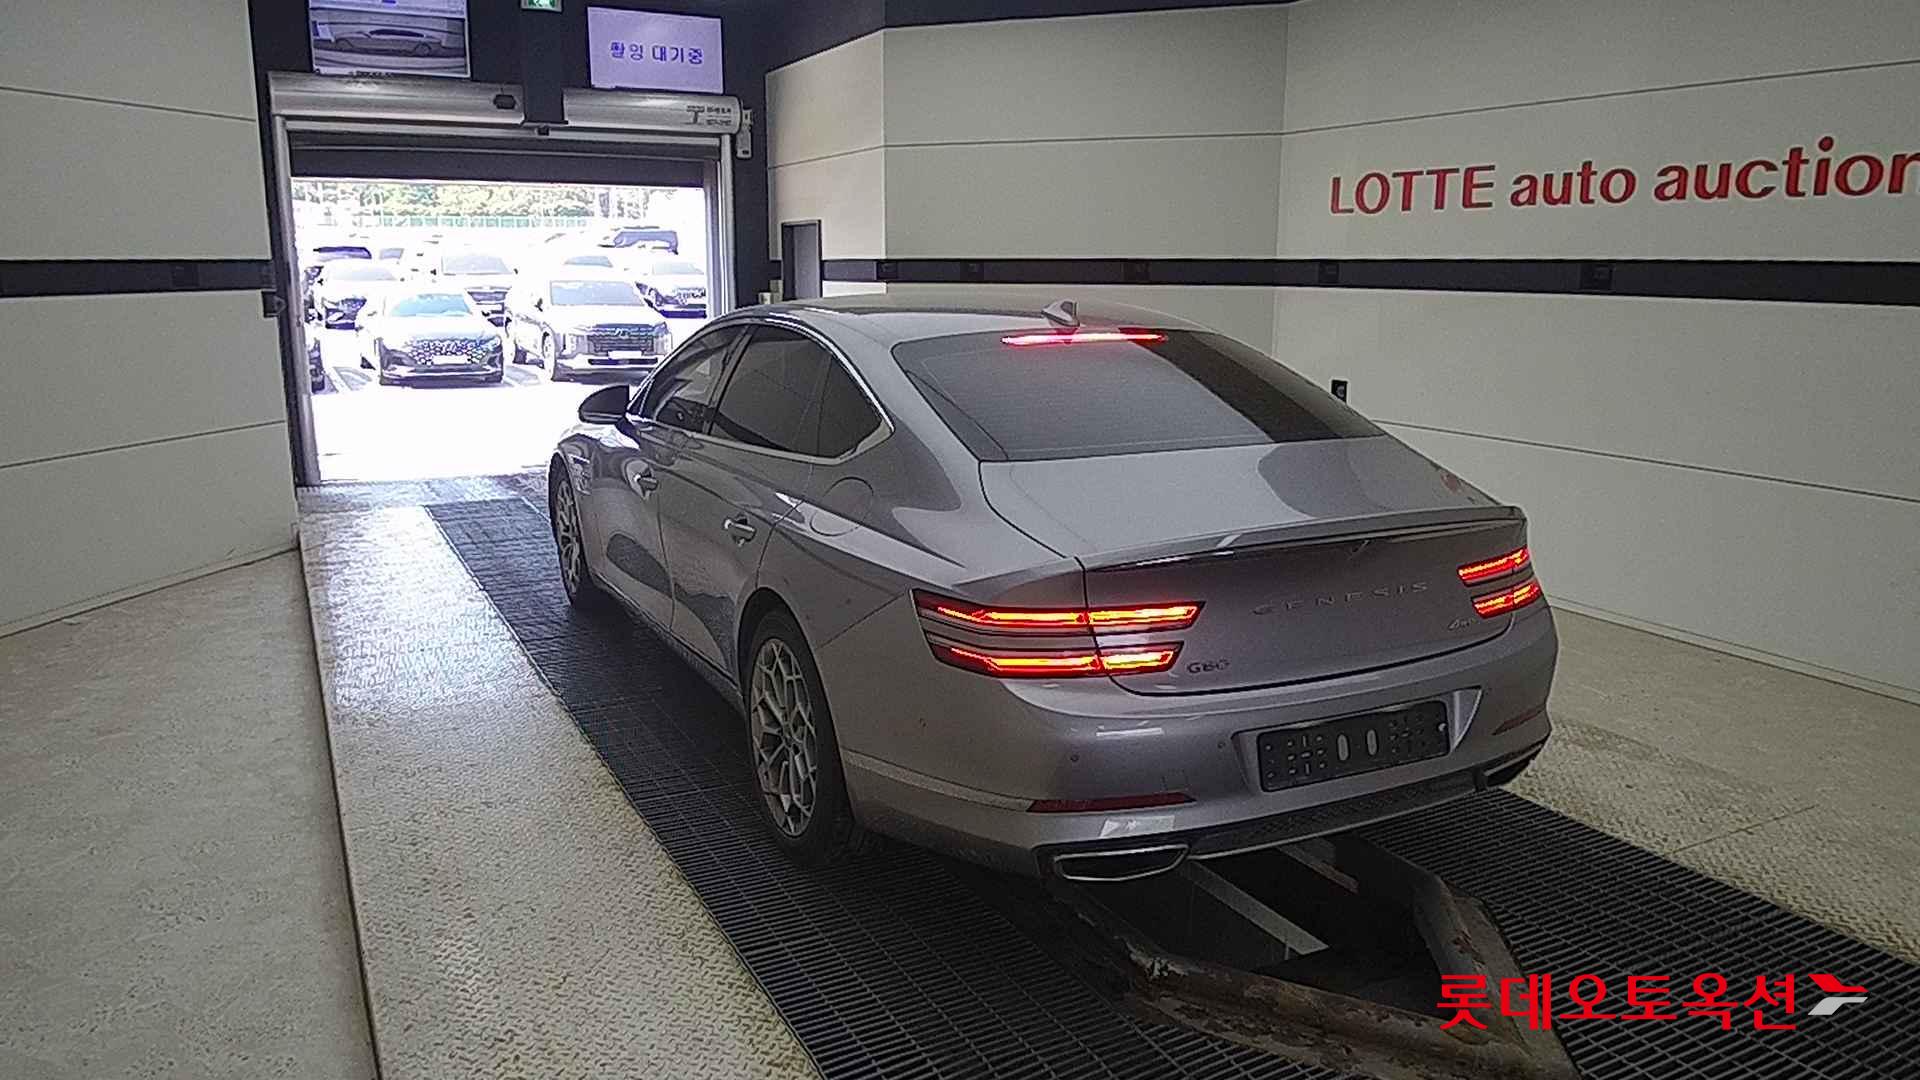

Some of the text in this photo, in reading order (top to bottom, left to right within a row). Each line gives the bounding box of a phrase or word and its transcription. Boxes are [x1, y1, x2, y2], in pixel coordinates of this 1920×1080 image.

[651, 44, 703, 65] 대기중
[1330, 165, 1496, 214] LOTTE
[1510, 160, 1637, 206] auto
